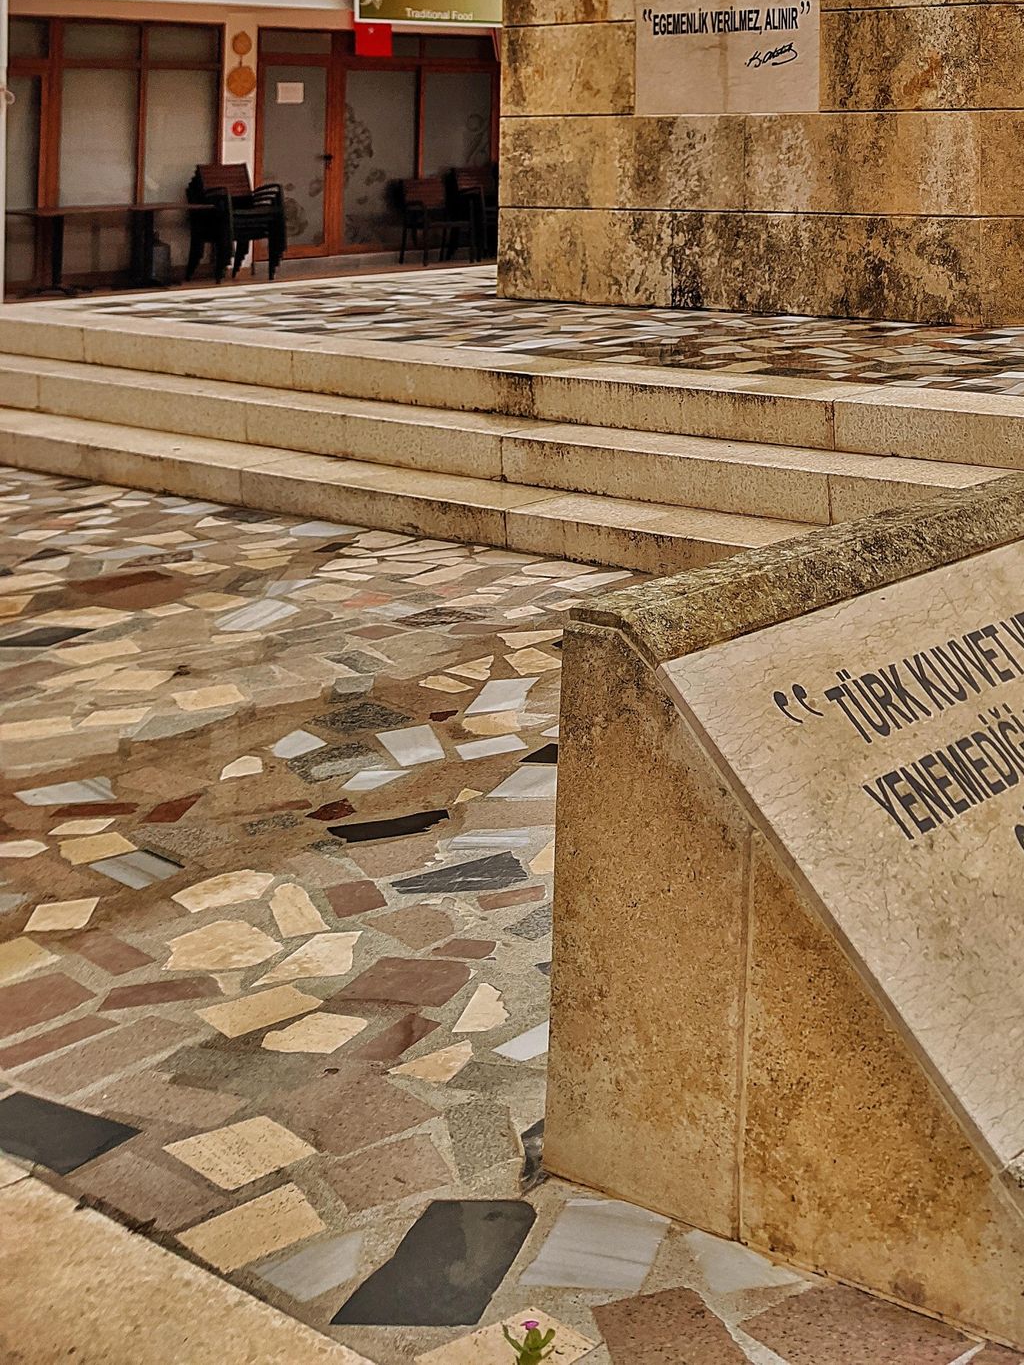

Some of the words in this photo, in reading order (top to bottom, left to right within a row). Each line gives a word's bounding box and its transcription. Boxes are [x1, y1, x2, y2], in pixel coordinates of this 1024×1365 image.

[405, 8, 450, 20] Traditional
[451, 11, 473, 21] Food
[711, 6, 763, 35] VERİLMEZ,
[902, 624, 1024, 711] KUVVET
